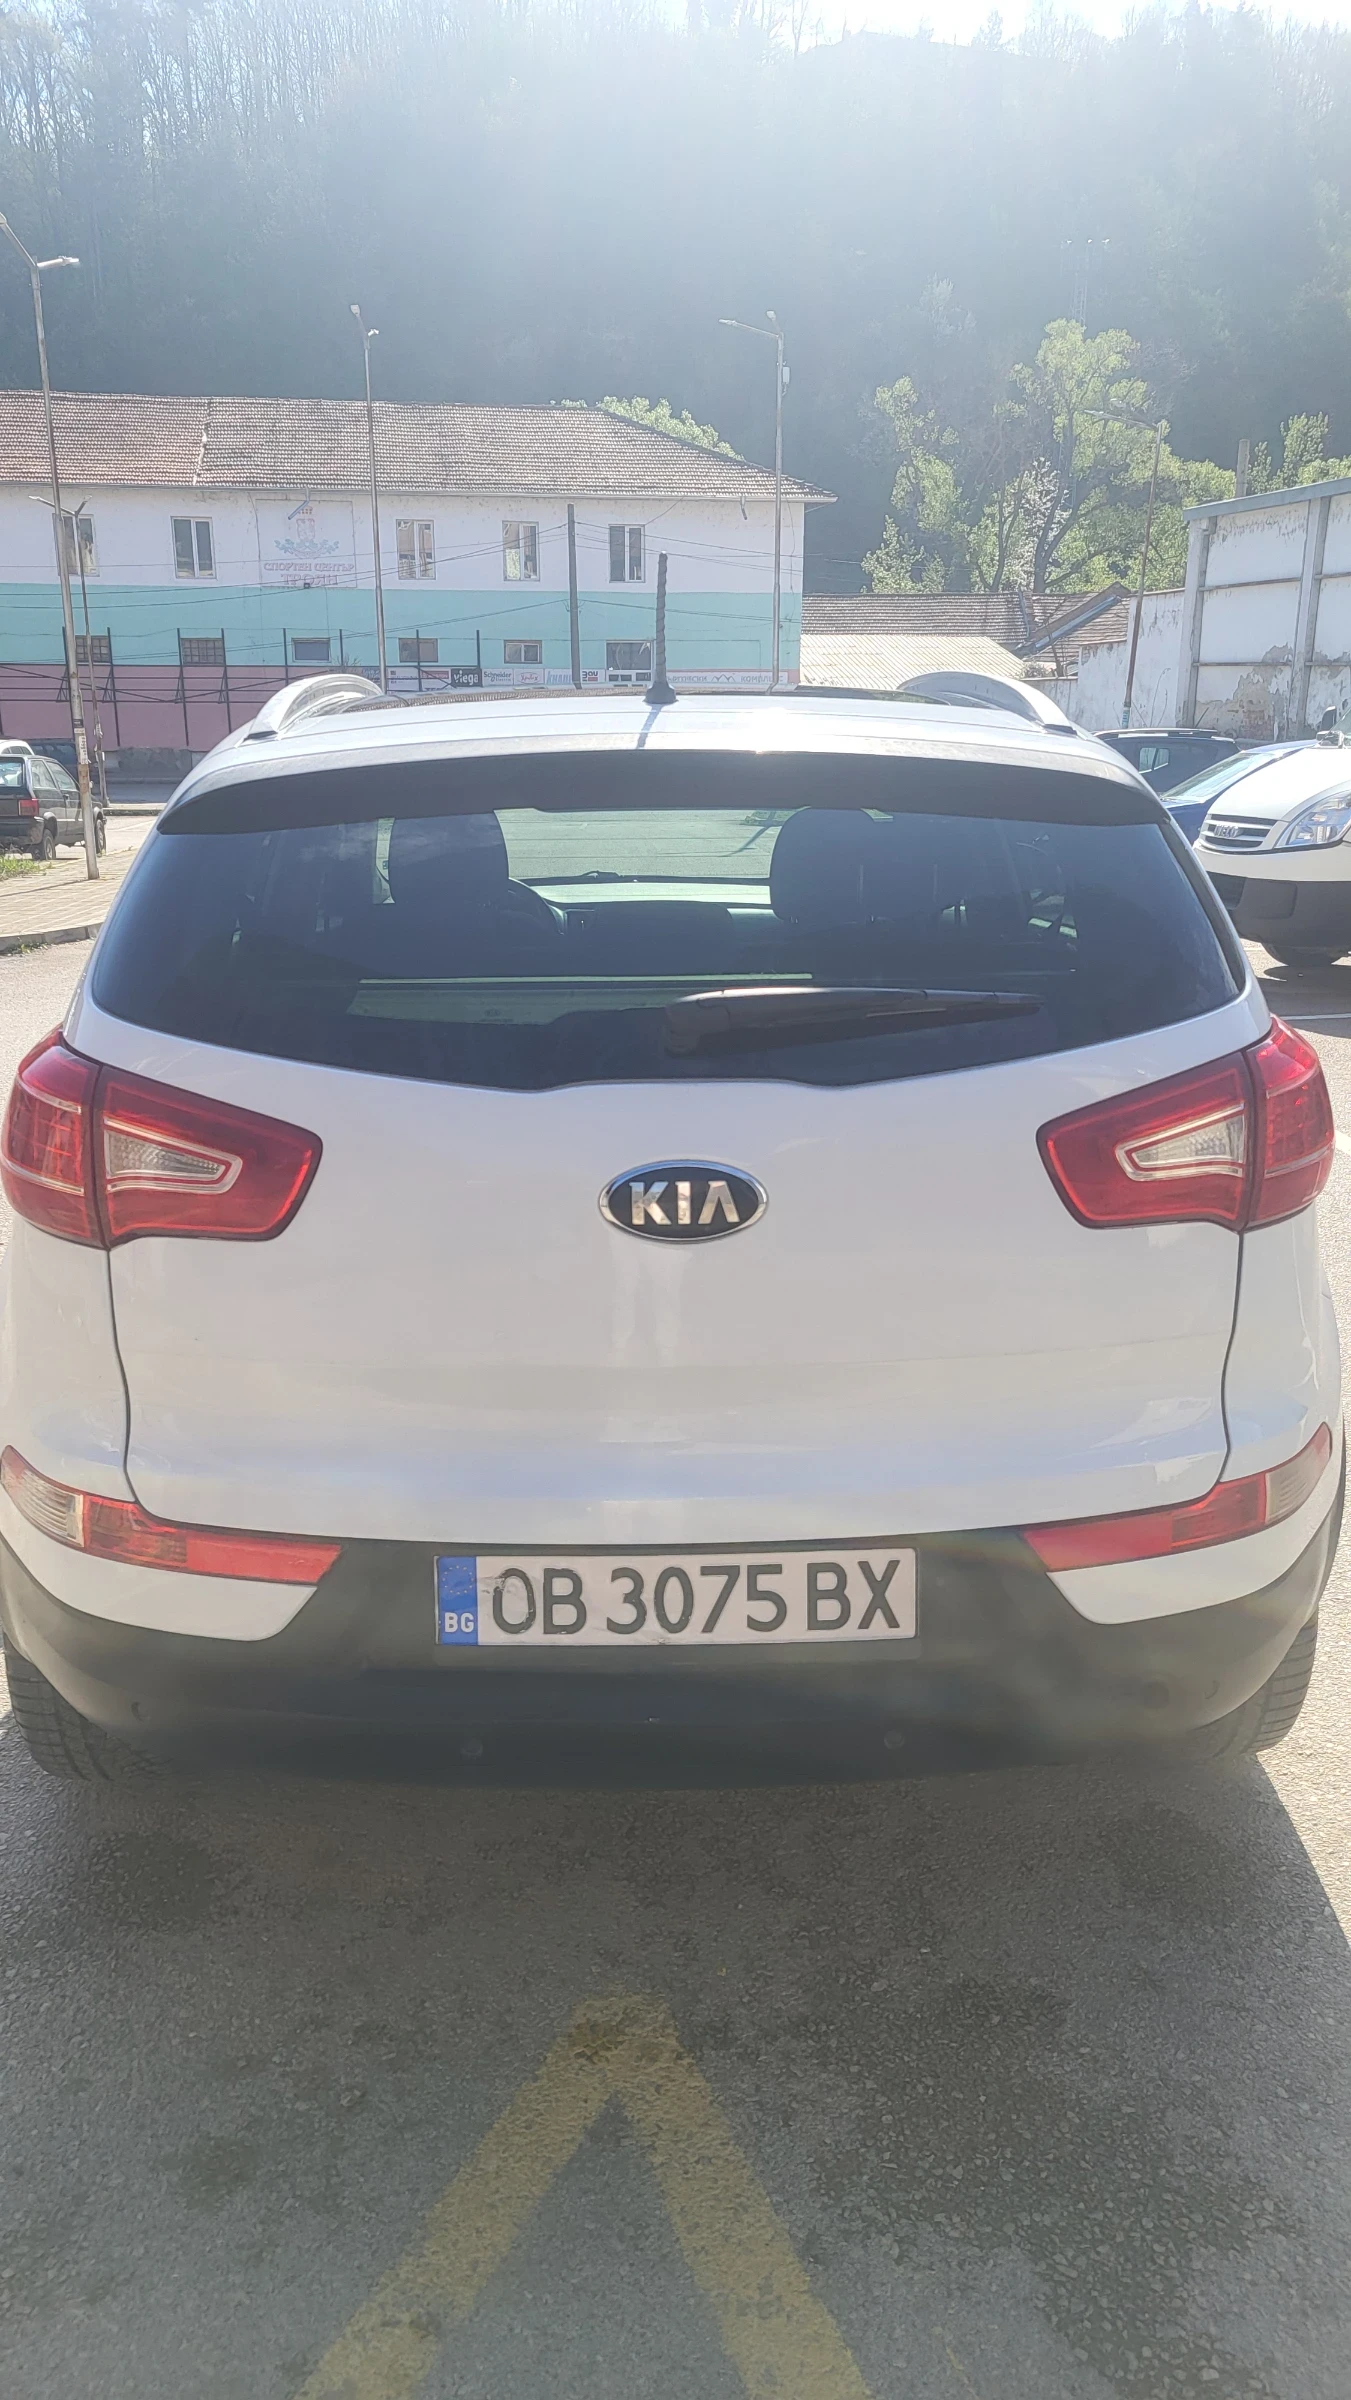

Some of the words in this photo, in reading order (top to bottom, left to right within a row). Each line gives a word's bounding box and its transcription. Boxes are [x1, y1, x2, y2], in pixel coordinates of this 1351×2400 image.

[263, 562, 312, 572] СПОРТЕН
[314, 563, 355, 572] ЦЕНТЪР
[281, 573, 338, 586] ТРОЯН
[453, 670, 479, 686] viega
[740, 675, 784, 683] КОМПЛЕС
[629, 1180, 740, 1225] KIA
[606, 1564, 788, 1635] 3075
[806, 1559, 901, 1632] BX
[444, 1612, 475, 1634] BG
